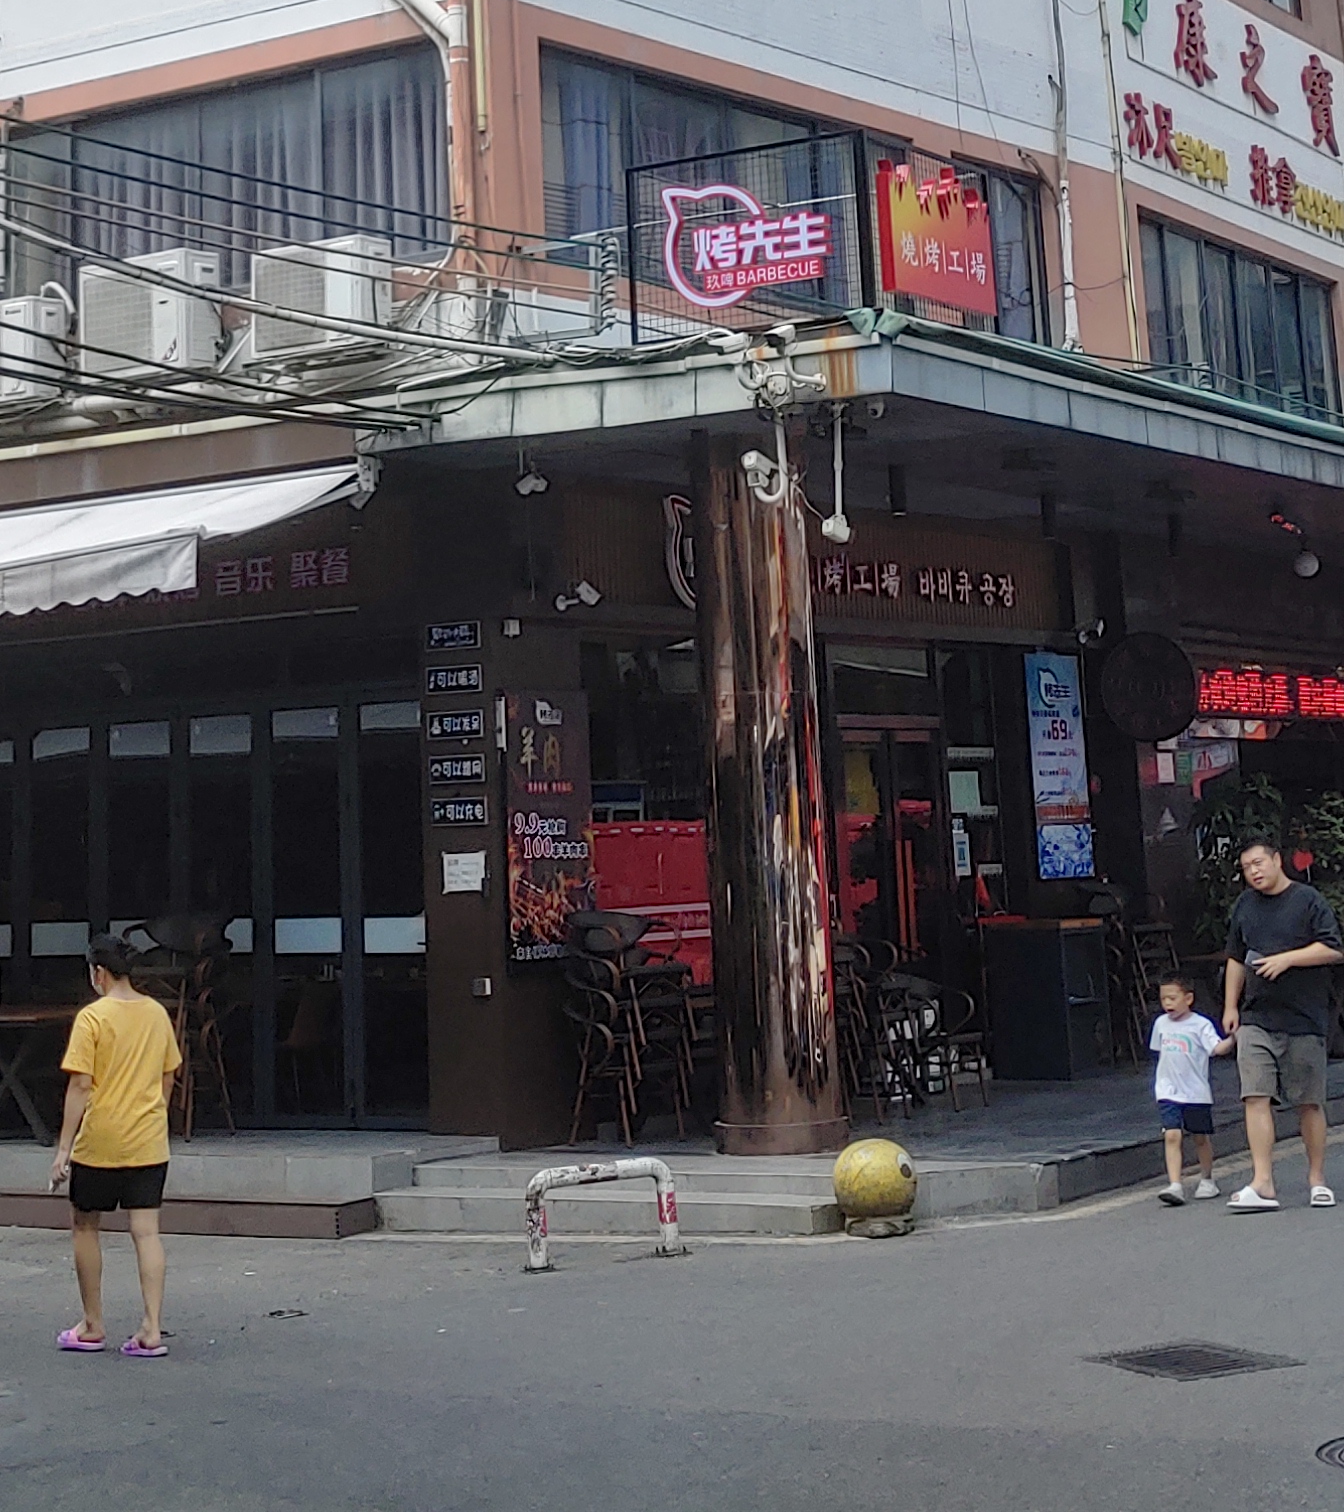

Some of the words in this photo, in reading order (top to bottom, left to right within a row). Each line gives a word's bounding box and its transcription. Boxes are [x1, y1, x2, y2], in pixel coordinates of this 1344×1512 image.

[692, 212, 832, 274] 烤先生
[736, 260, 820, 287] BARBECUE
[216, 555, 275, 595] 音乐
[291, 548, 350, 588] 聚餐
[918, 567, 973, 605] 바비큐
[979, 574, 1015, 607] 공장
[1052, 719, 1068, 740] 69
